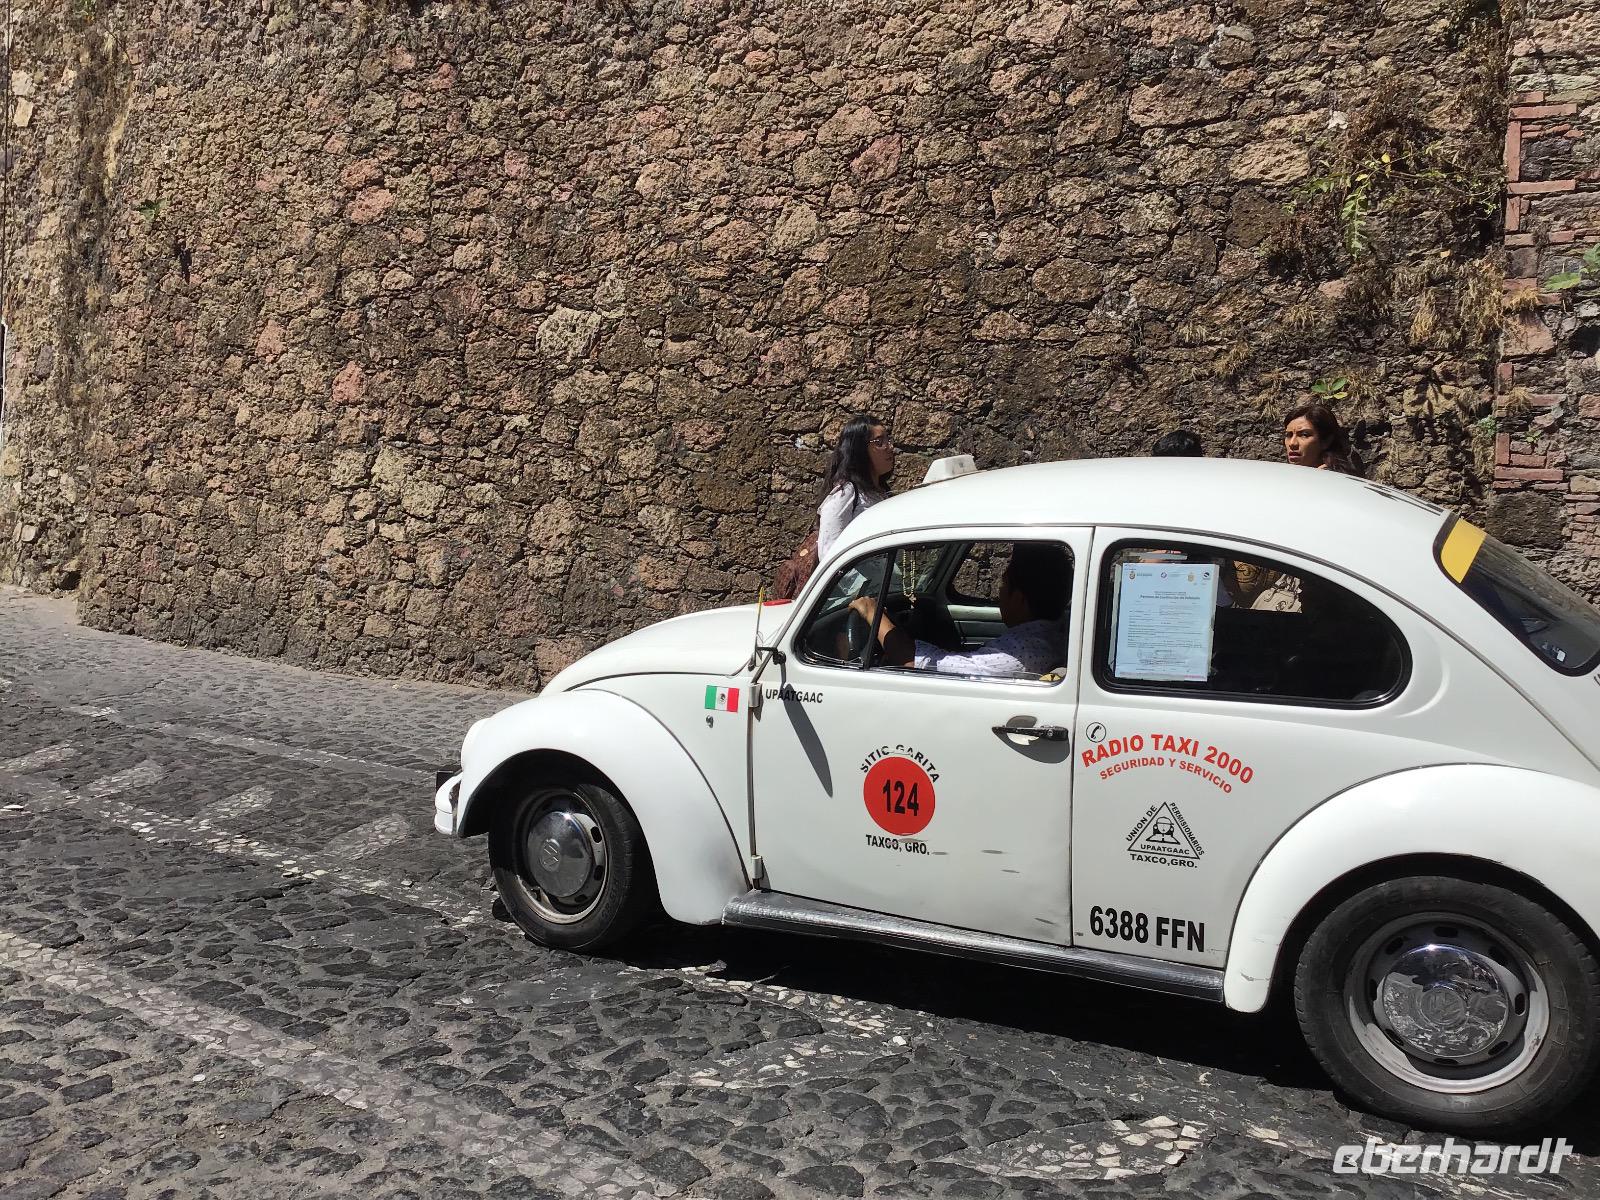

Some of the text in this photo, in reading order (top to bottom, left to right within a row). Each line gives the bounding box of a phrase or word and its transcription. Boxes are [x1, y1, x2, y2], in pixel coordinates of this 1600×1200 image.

[765, 688, 824, 704] UPAATGAAC
[1081, 733, 1254, 784] RADIO TAXI 2000
[1099, 757, 1233, 794] SEGURIDAD Y SERVICIO
[882, 779, 919, 817] 124
[1125, 805, 1158, 842] UNION DE
[1169, 802, 1205, 856] PERMISIONARIOS
[865, 834, 930, 856] TAXCO, GRO.
[1140, 843, 1190, 855] UPAATGAAC
[1089, 905, 1205, 953] 6388 FFN
